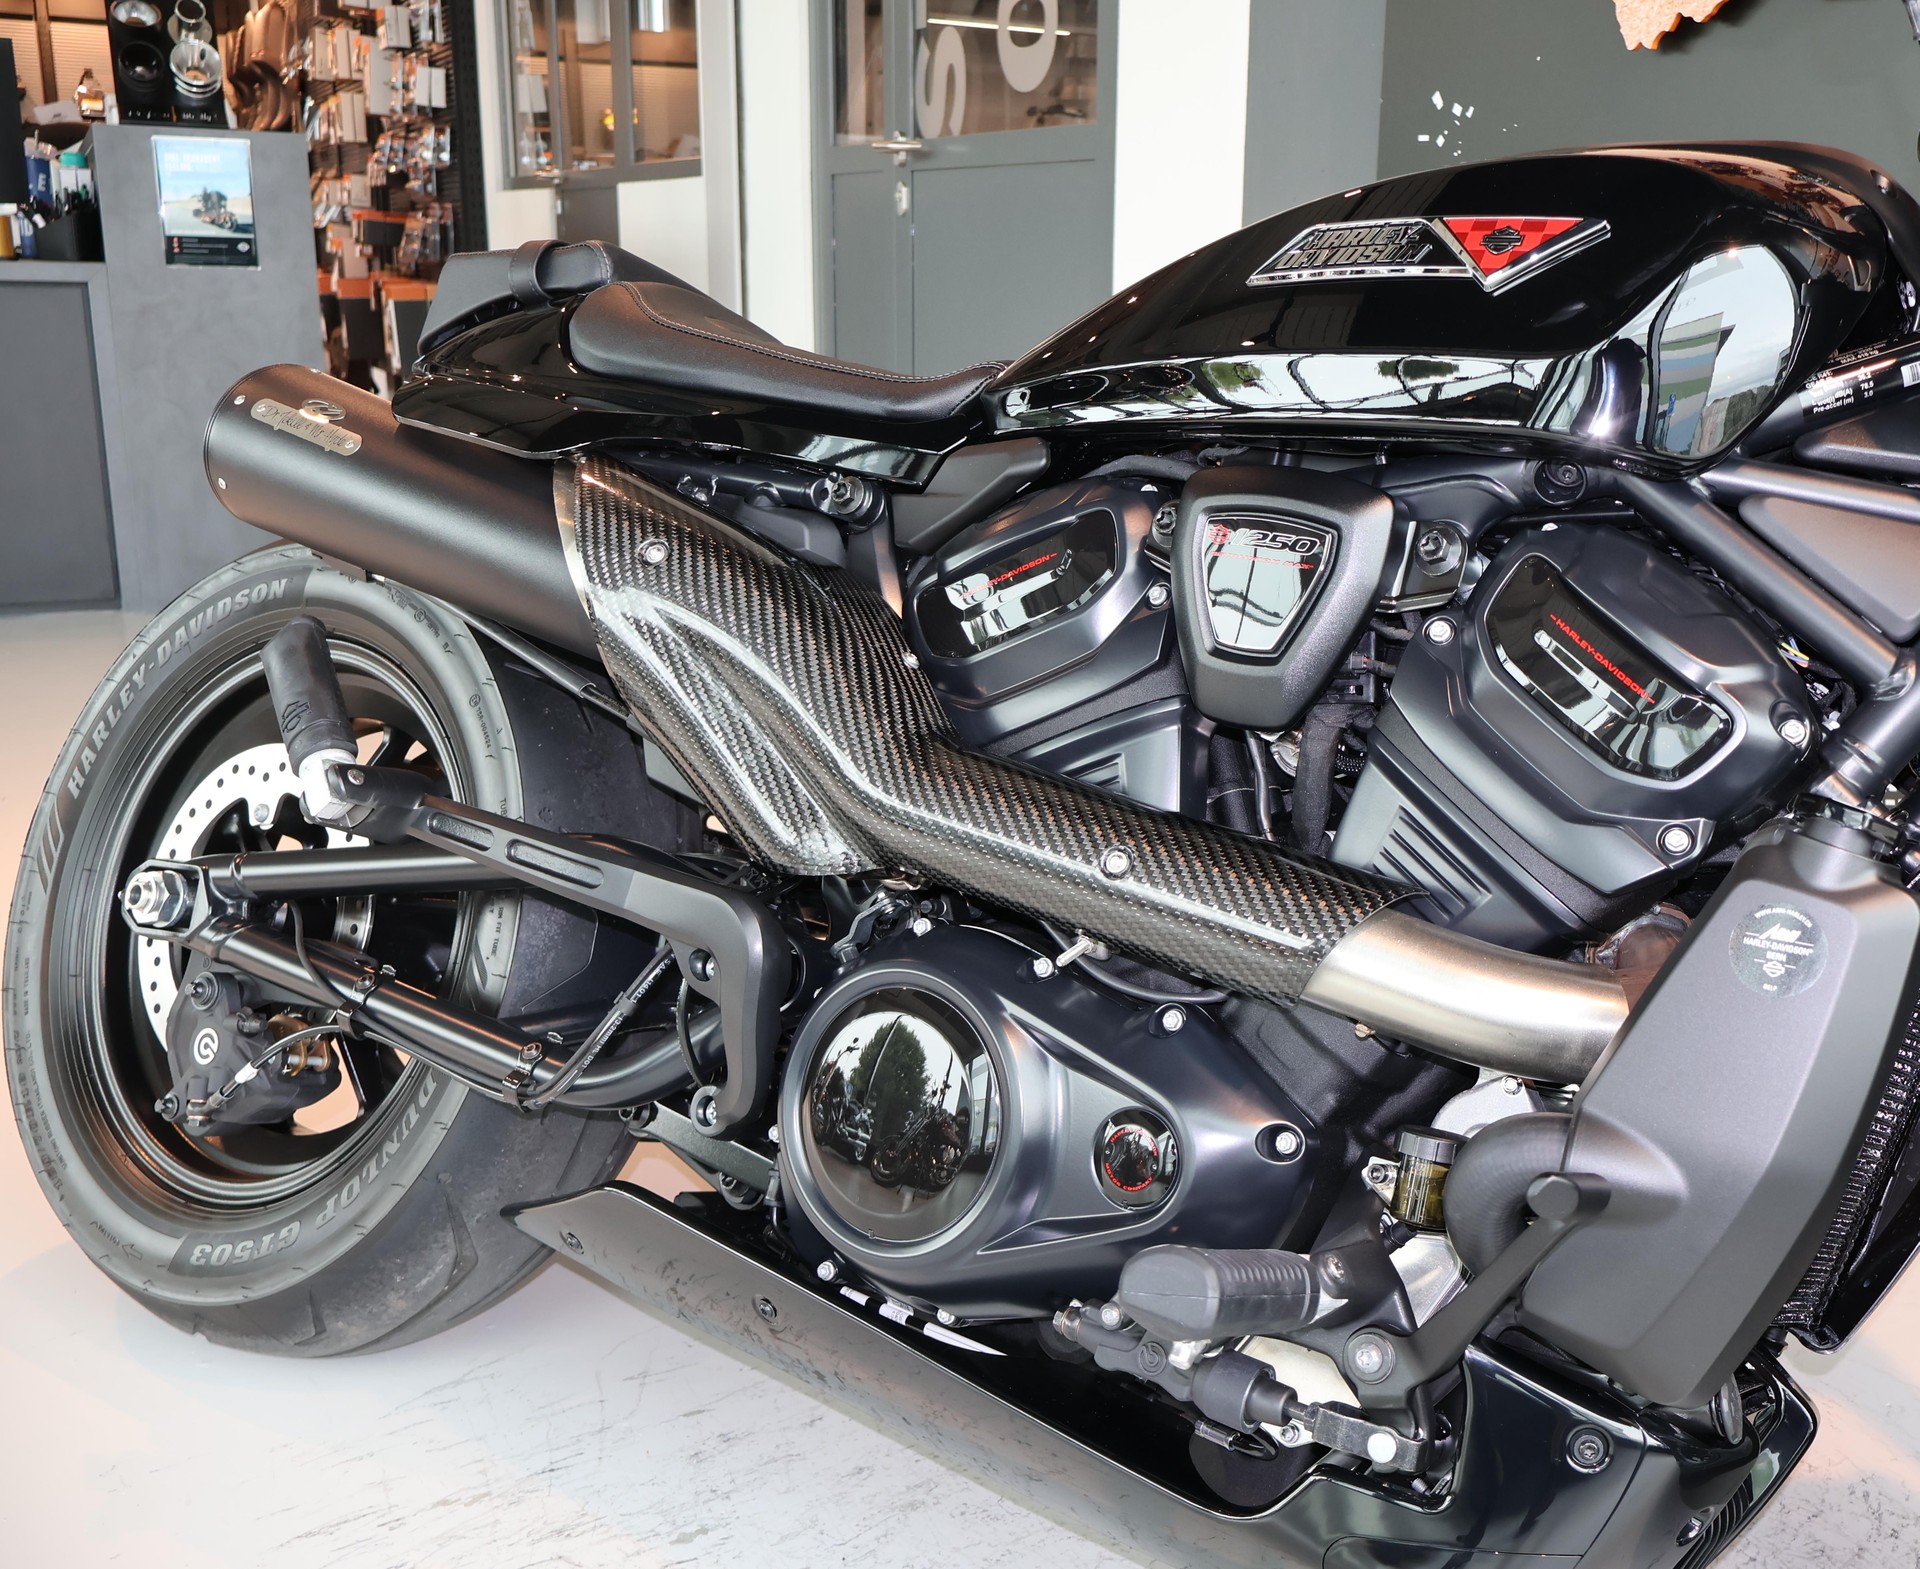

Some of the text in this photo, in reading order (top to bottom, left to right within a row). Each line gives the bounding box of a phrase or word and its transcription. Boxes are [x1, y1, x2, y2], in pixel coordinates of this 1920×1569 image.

[1275, 243, 1433, 270] DAVIDSON
[1813, 390, 1874, 414] Pre-accel (m) 3.0
[1228, 527, 1320, 556] 1250
[1556, 618, 1648, 699] HARLEY-DAVIDSON
[67, 577, 288, 800] HARLEY-DAVIDSON
[1766, 950, 1787, 962] BERN
[315, 1068, 440, 1229] DUNLOP
[1104, 1162, 1153, 1192] MOTOR COMPANY
[189, 1219, 301, 1266] GT503
